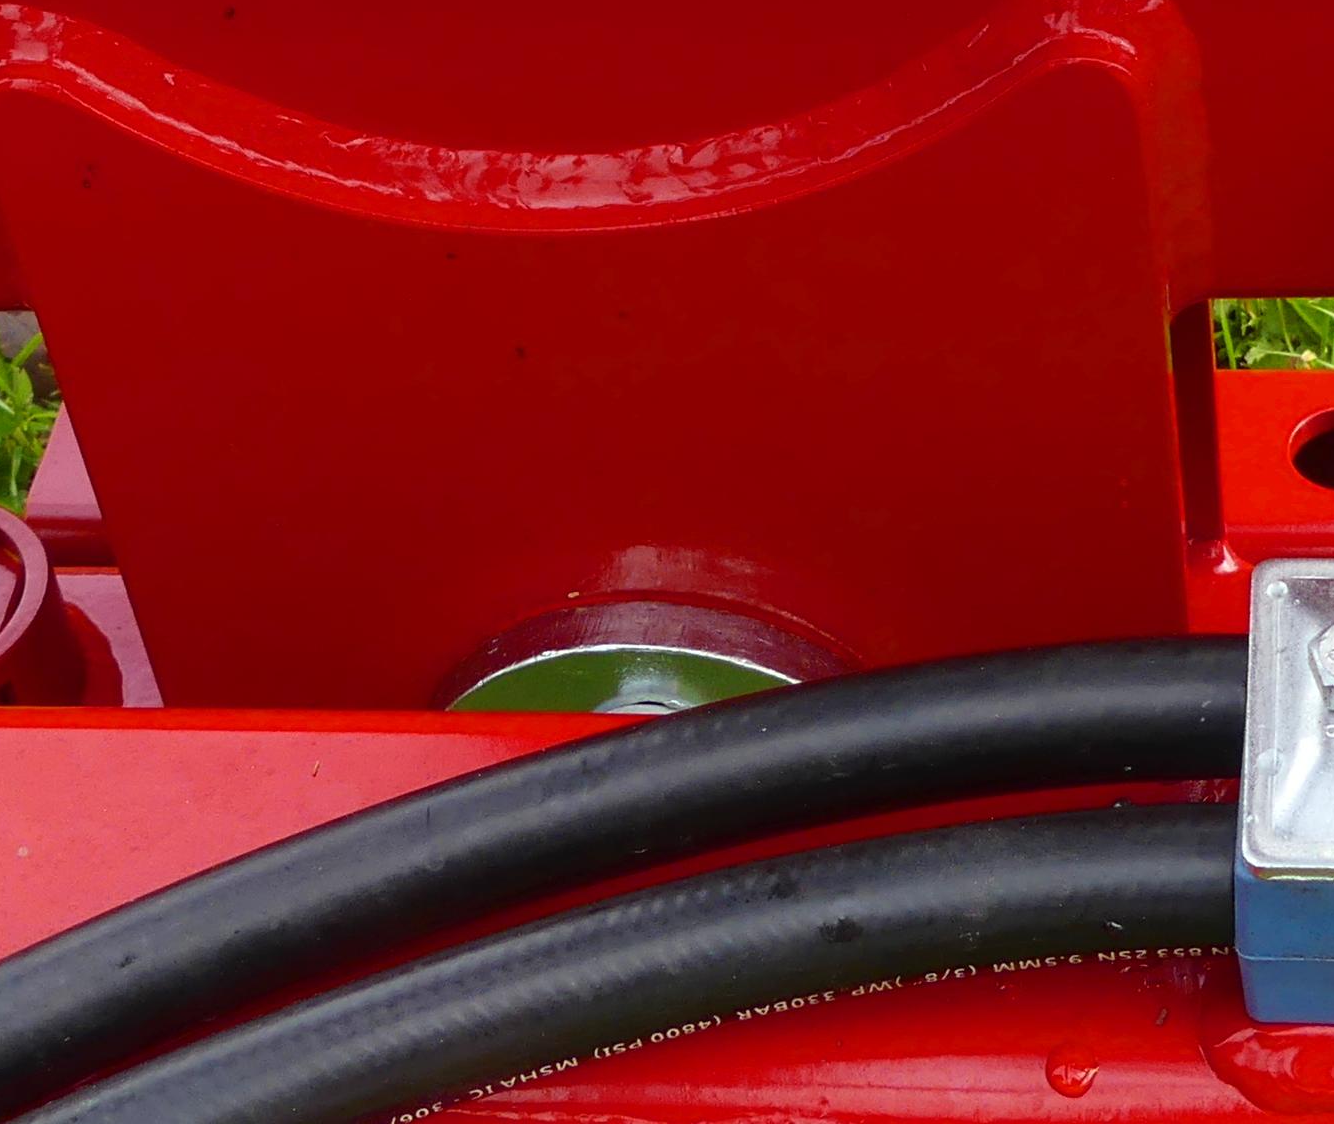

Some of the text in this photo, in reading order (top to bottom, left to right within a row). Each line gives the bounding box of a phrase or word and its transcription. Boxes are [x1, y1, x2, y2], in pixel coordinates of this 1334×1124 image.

[1098, 949, 1148, 961] 2SN
[1157, 947, 1203, 958] 853
[993, 954, 1083, 973] 9.5MM
[736, 990, 836, 1021] 330BAR
[650, 1014, 722, 1043] (4800
[593, 1038, 643, 1060] PSI)
[499, 1056, 579, 1088] MSHA
[469, 1084, 495, 1101] IC
